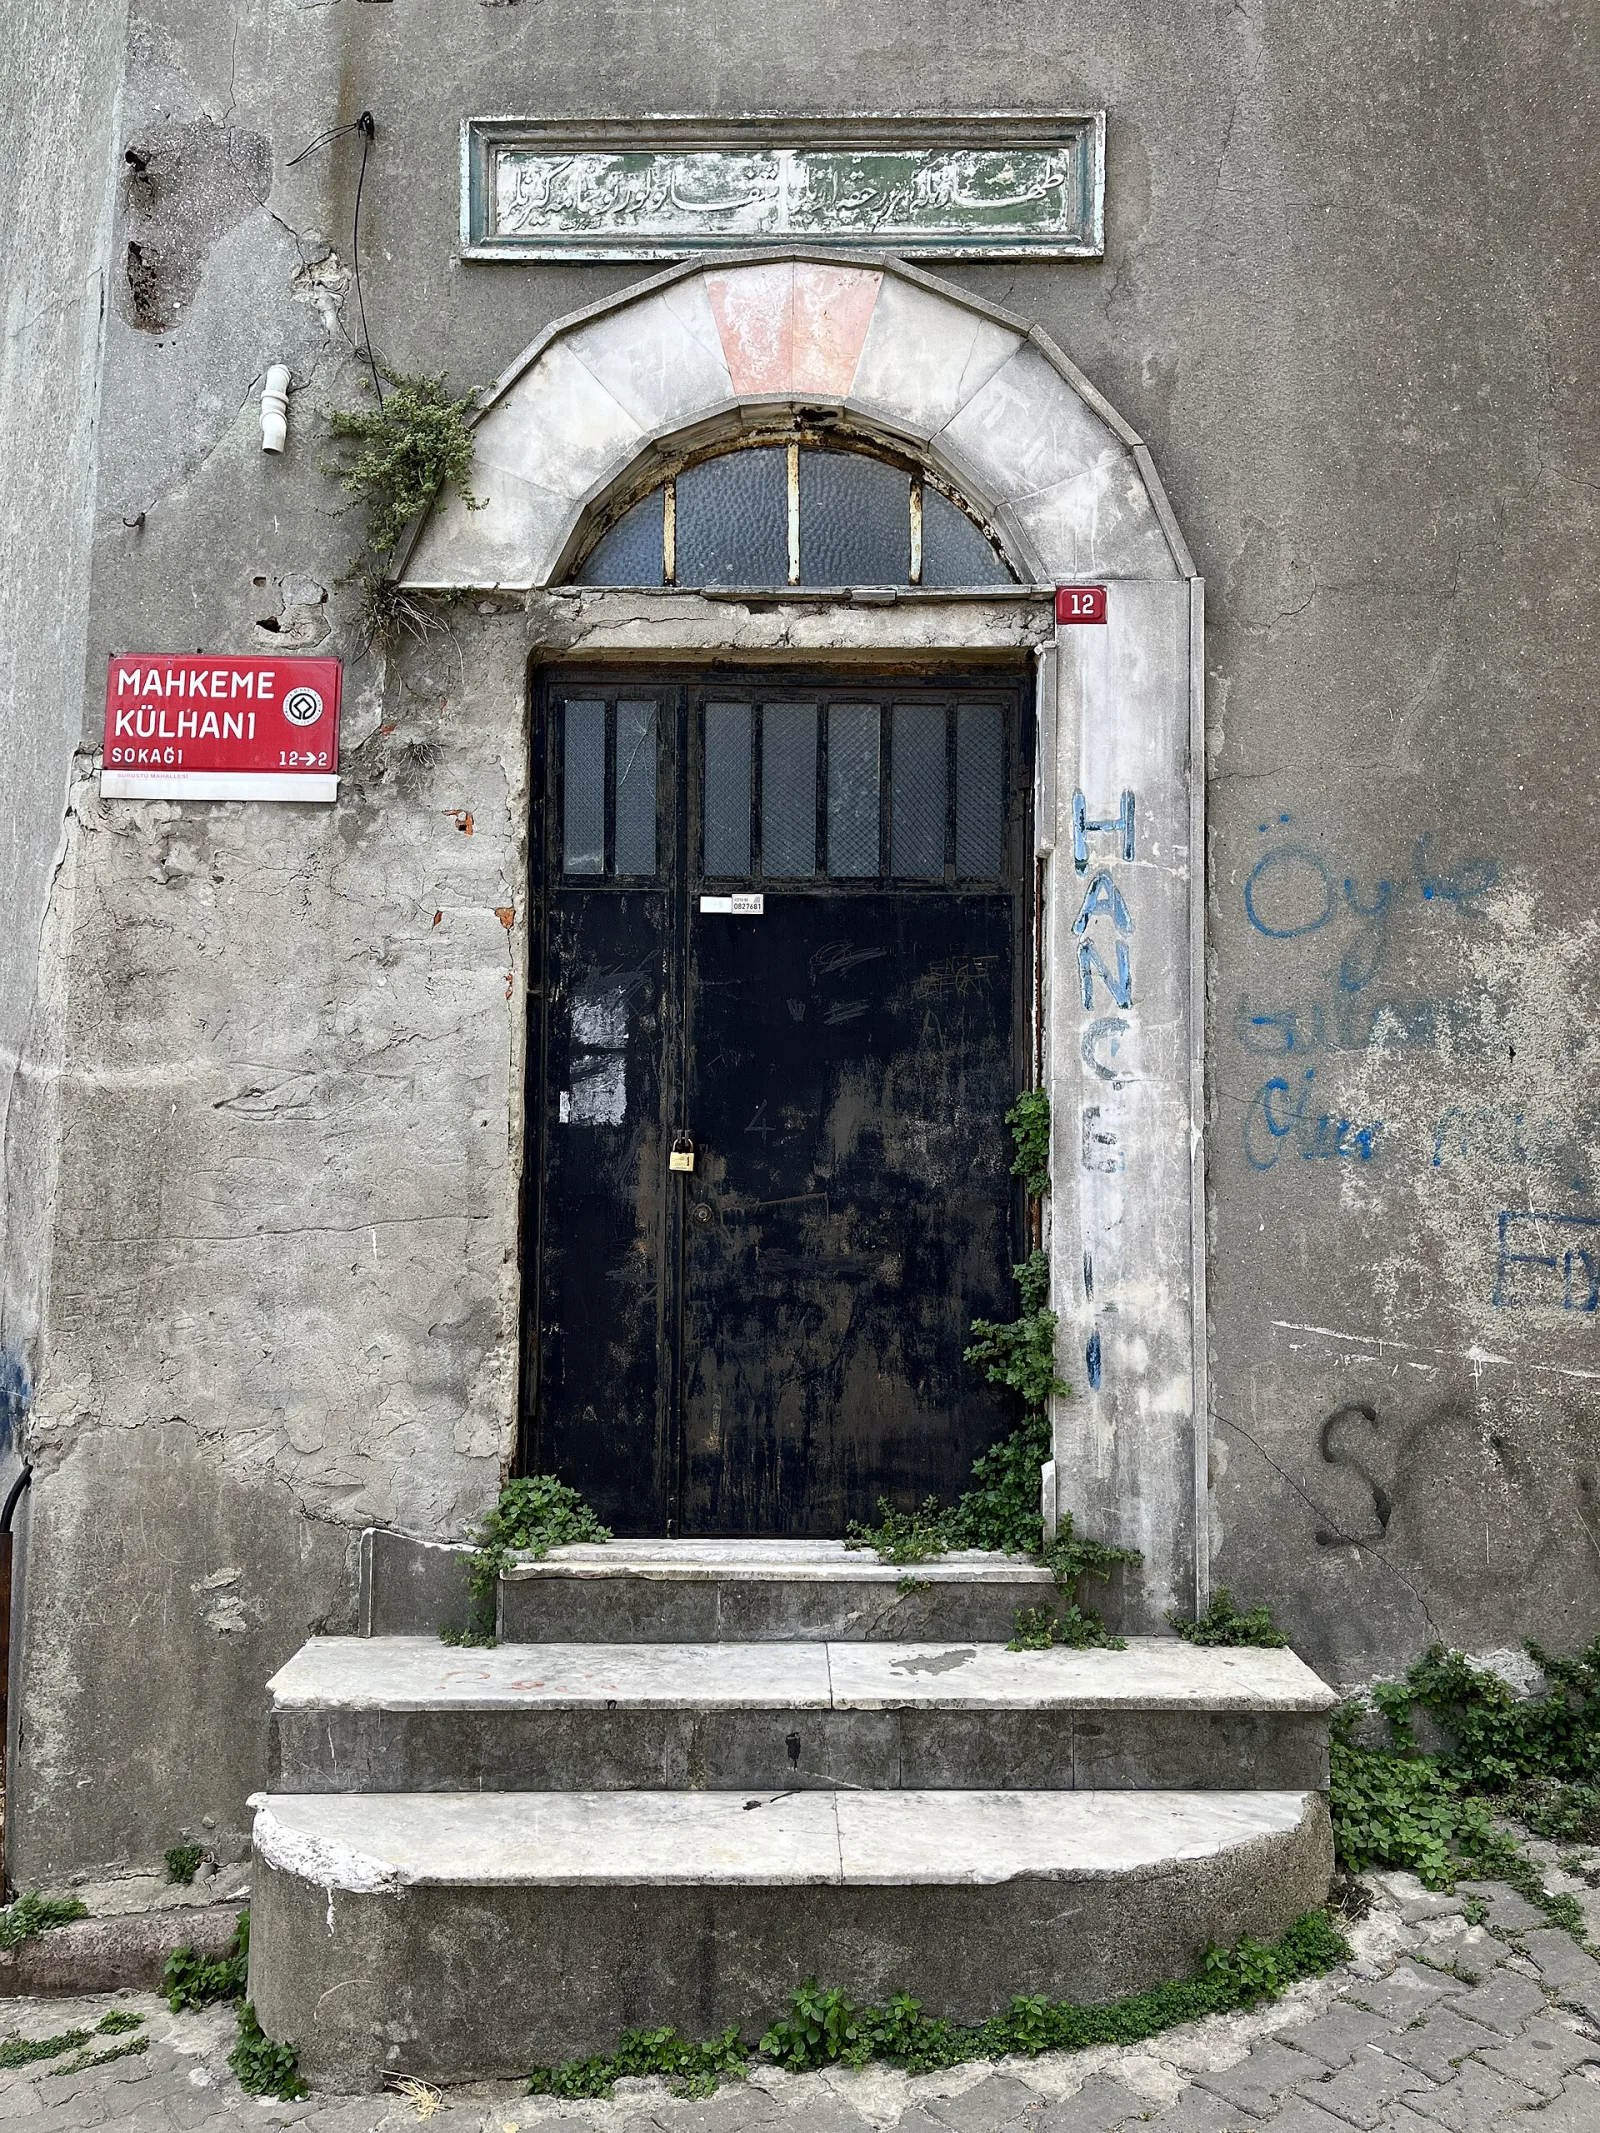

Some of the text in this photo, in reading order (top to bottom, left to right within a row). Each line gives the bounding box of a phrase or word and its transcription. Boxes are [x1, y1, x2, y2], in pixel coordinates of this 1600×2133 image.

[1071, 594, 1094, 614] 12
[117, 668, 276, 699] MAHKEME
[114, 704, 256, 740] KÜLHANI
[111, 746, 183, 764] SOKAĞI
